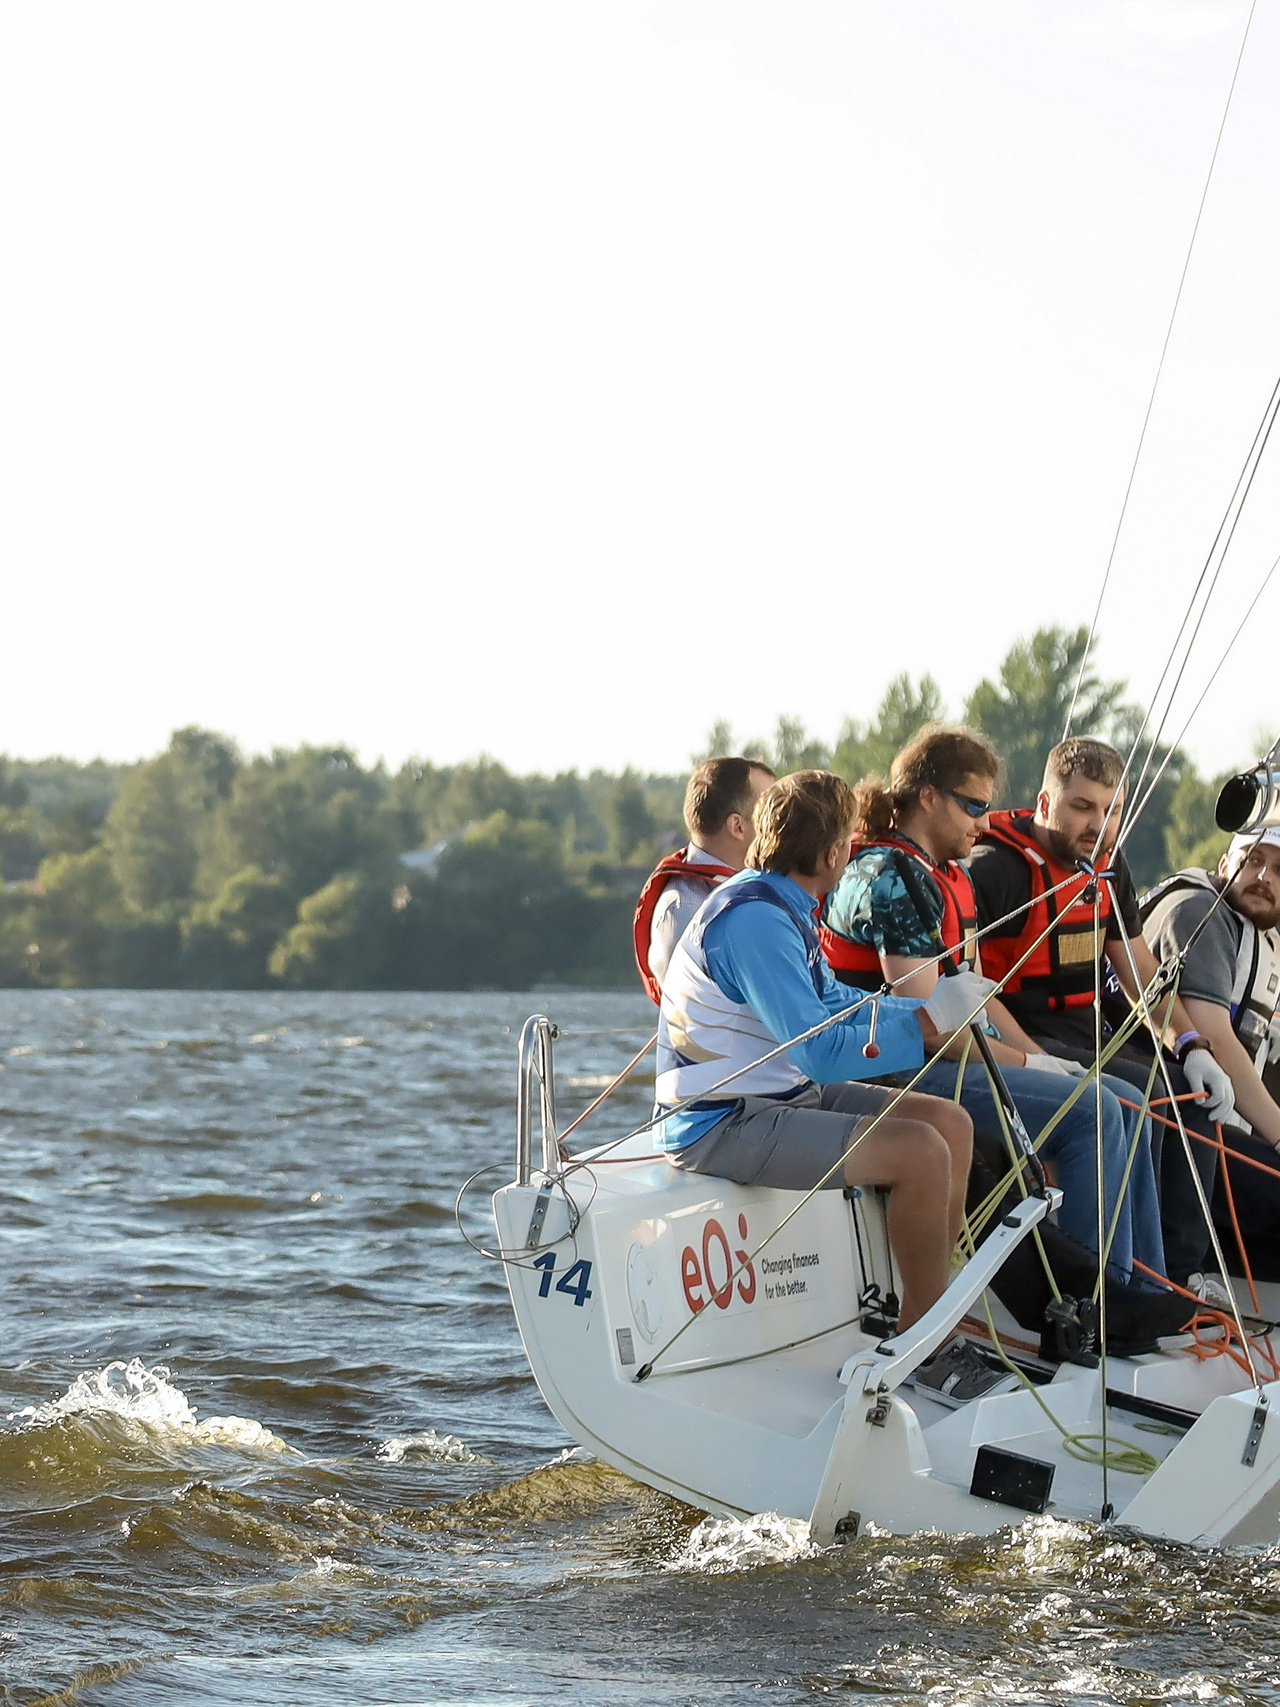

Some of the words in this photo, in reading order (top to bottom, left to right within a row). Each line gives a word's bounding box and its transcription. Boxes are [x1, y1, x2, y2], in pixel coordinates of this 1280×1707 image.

[761, 1255, 793, 1275] Changing
[792, 1253, 820, 1269] finances
[533, 1251, 593, 1307] 14
[765, 1283, 775, 1300] for
[775, 1281, 786, 1298] the
[786, 1279, 809, 1296] better.
